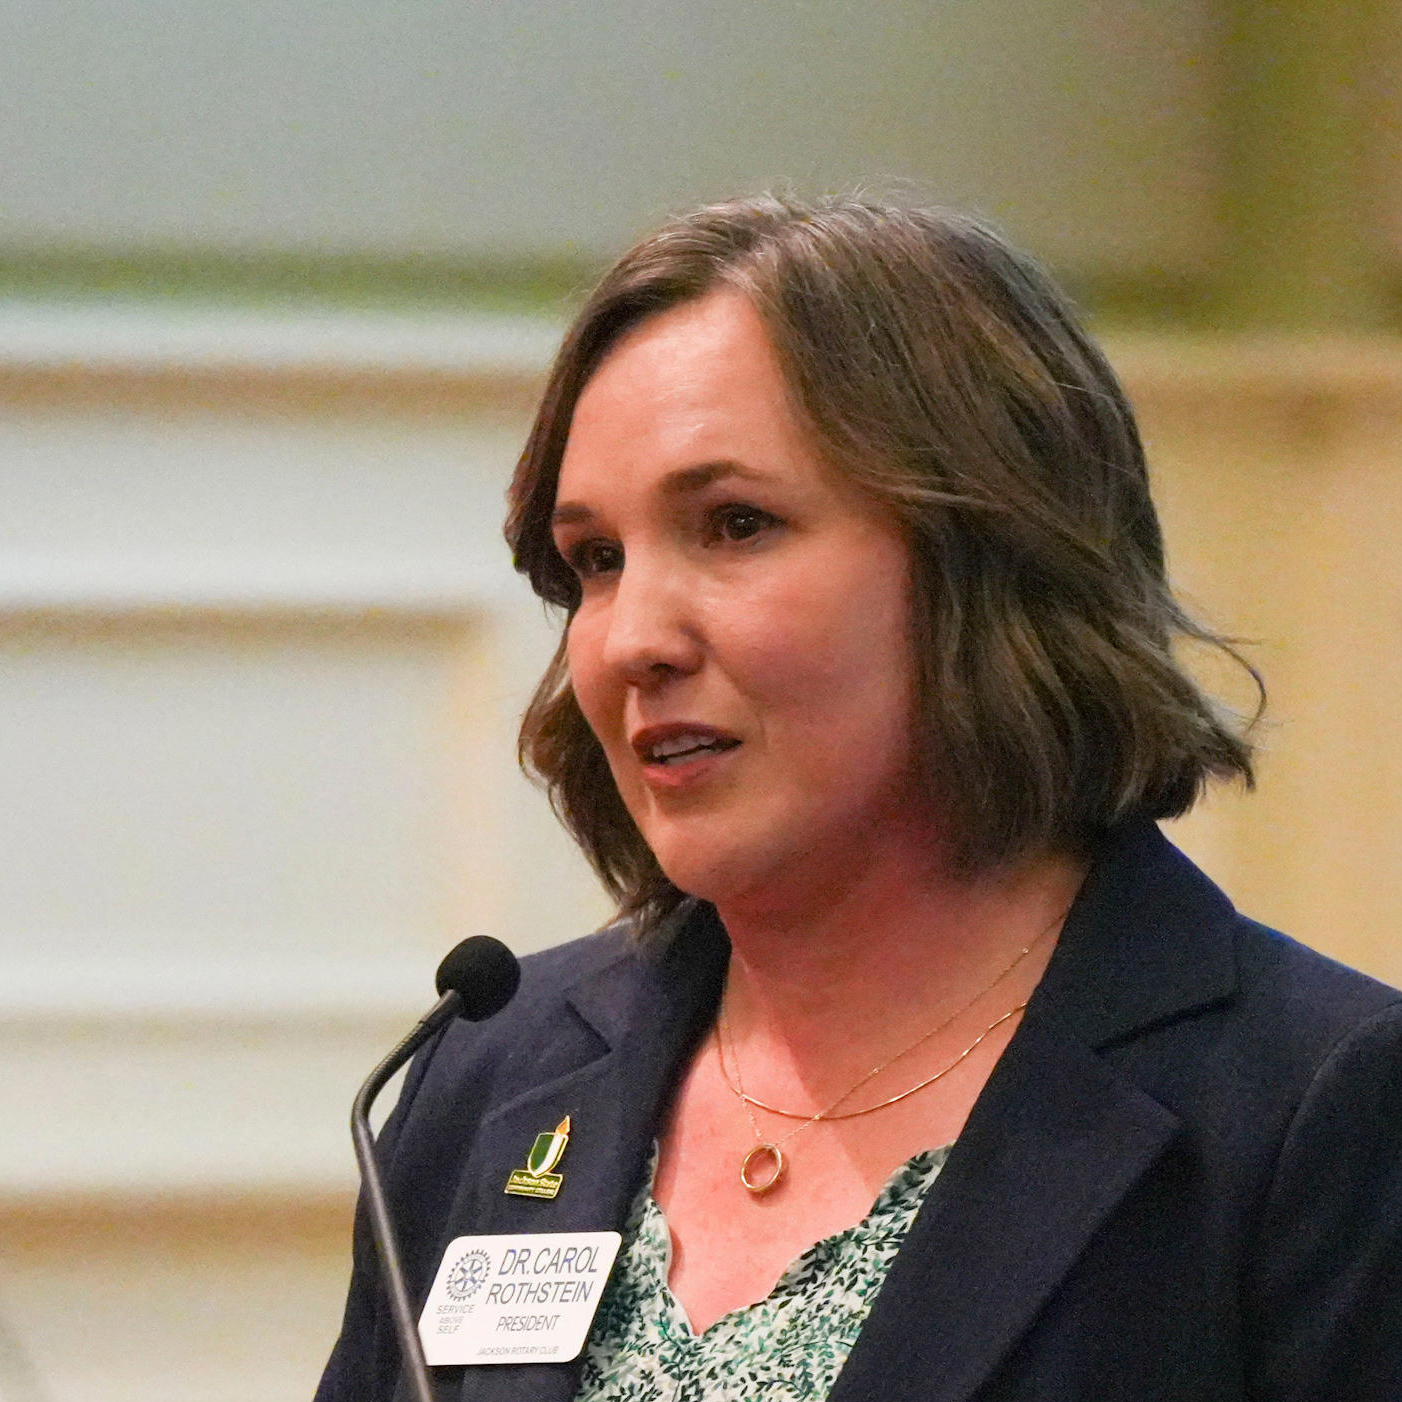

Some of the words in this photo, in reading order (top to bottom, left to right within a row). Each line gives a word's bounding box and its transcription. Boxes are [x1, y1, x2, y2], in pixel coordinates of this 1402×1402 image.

[485, 1281, 594, 1305] ROTHSTEIN
[436, 1304, 475, 1315] SERVICE
[496, 1315, 560, 1332] PRESIDENT
[436, 1325, 460, 1335] SELF
[477, 1346, 510, 1356] JACKSON
[511, 1346, 538, 1355] ROTARY
